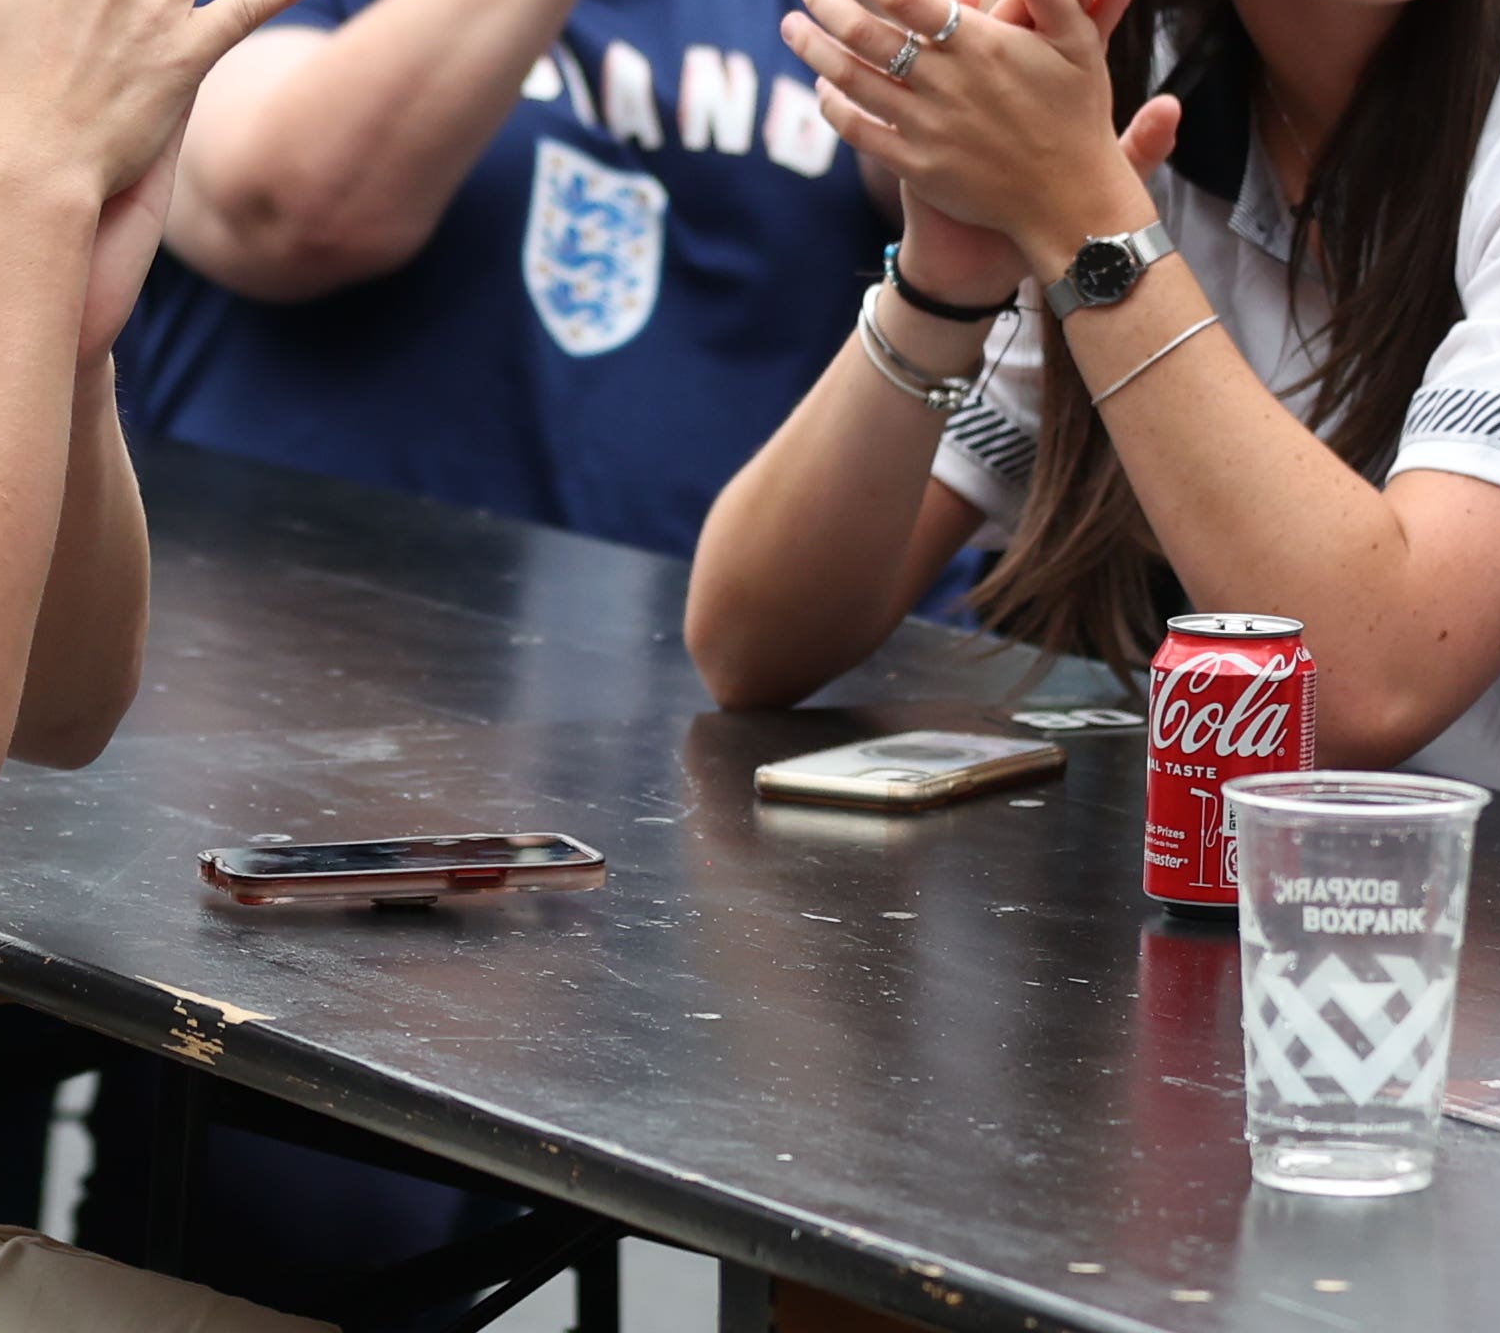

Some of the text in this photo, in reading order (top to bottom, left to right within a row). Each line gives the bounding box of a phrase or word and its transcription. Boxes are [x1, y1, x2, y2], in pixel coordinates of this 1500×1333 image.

[1165, 761, 1217, 779] TASTE
[1157, 825, 1186, 840] Prizes
[1302, 906, 1427, 935] BOXPARK
